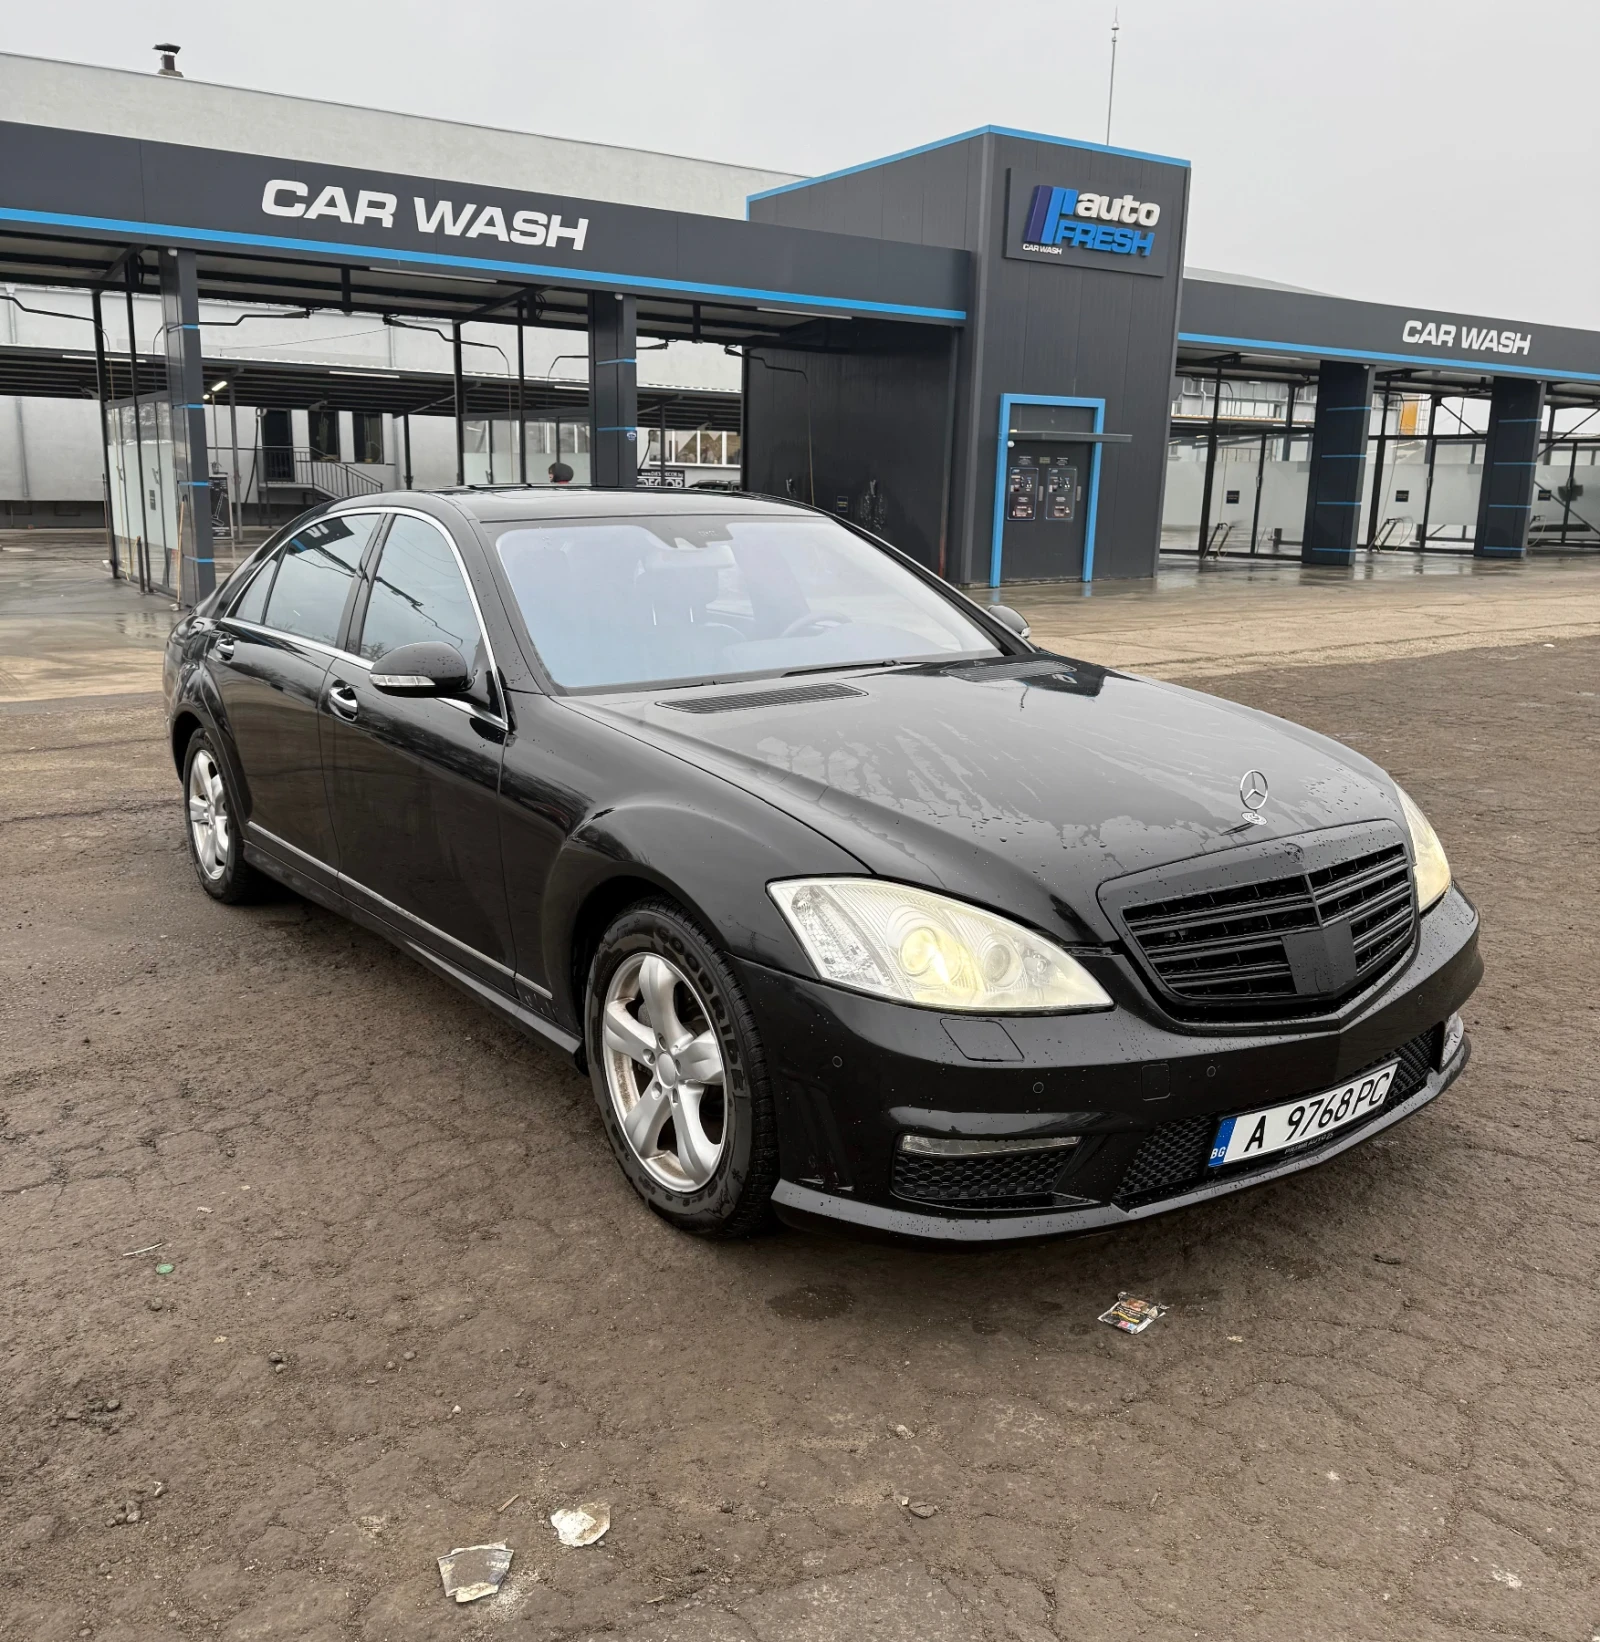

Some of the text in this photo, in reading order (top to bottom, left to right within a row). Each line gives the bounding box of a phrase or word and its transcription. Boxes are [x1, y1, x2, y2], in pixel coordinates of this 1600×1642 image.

[261, 179, 589, 251] CAR WASH
[1075, 192, 1161, 227] auto
[1022, 243, 1063, 255] CAR WASH
[1054, 219, 1155, 257] FRESH
[1402, 320, 1532, 355] CAR WASH
[656, 924, 744, 1091] GOODRIDE
[1244, 1115, 1267, 1152] A
[1285, 1087, 1354, 1142] 9768
[1210, 1146, 1226, 1160] BG
